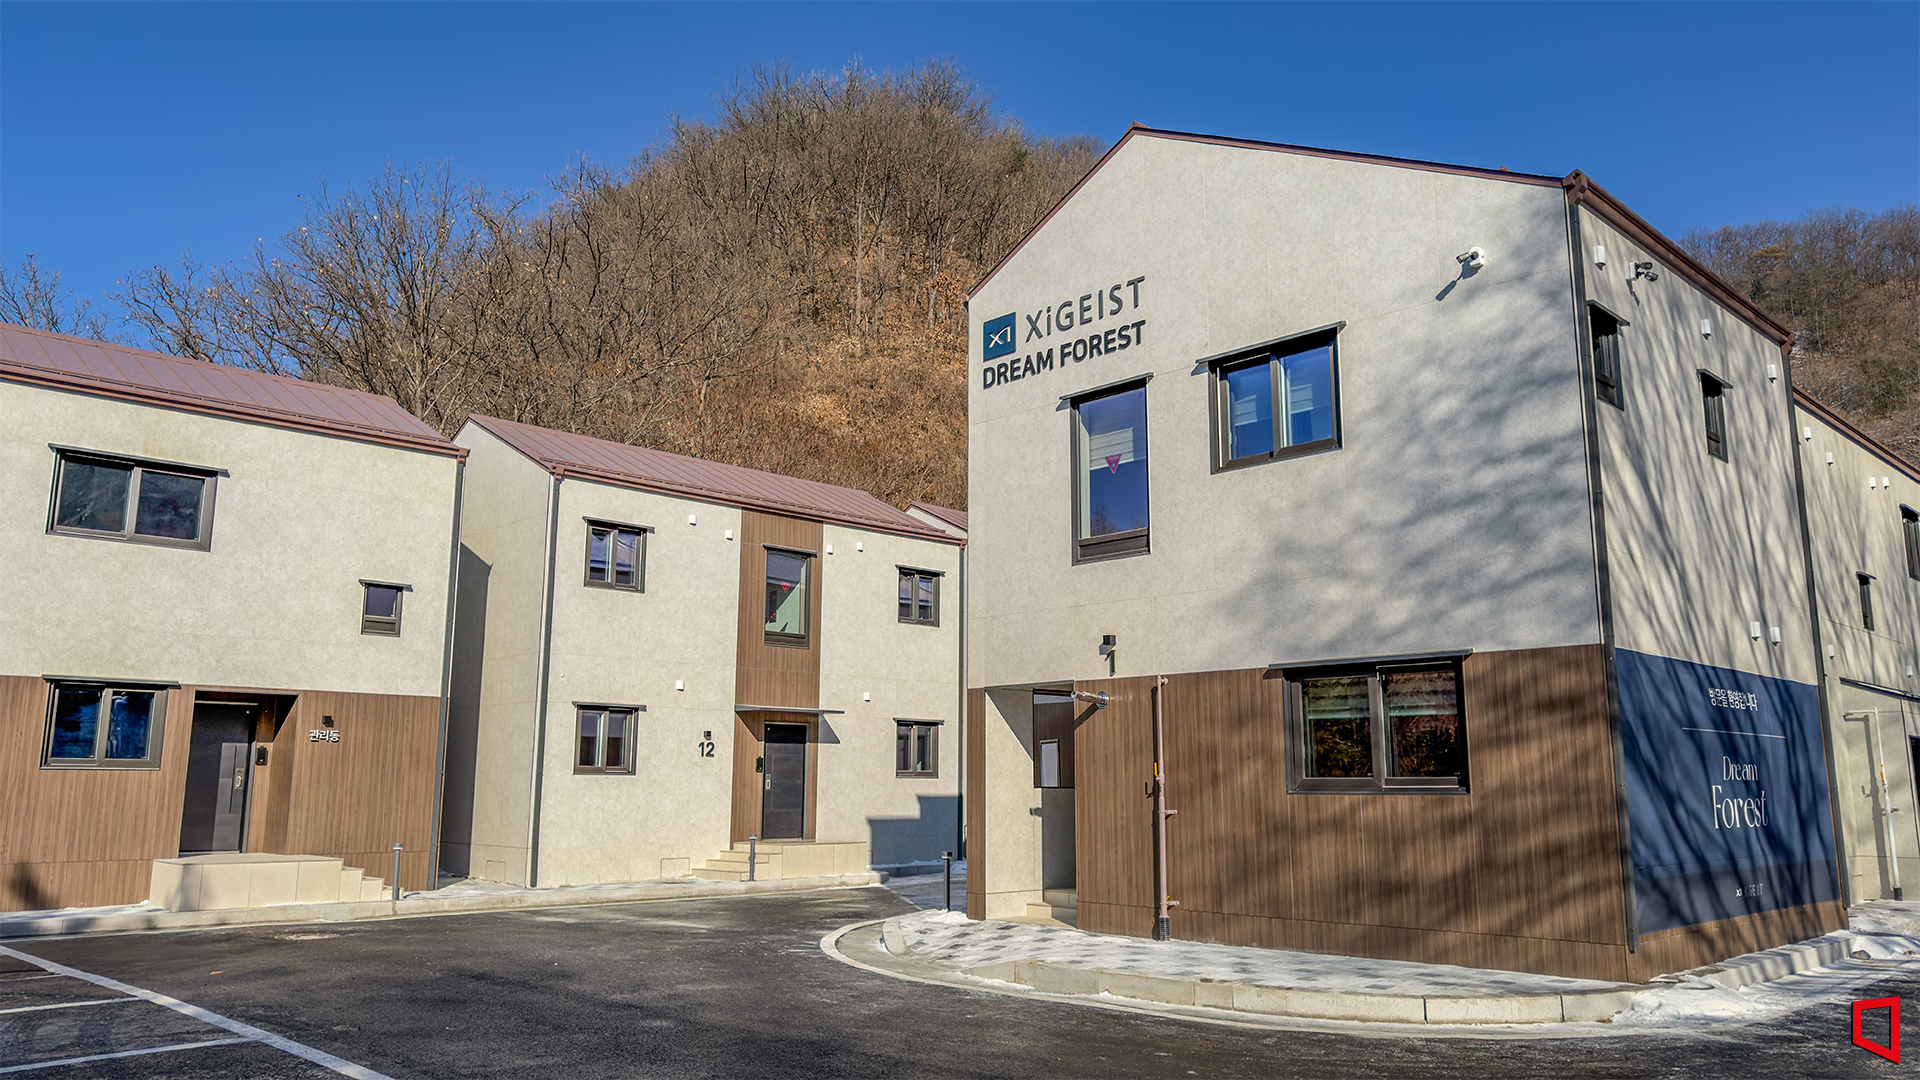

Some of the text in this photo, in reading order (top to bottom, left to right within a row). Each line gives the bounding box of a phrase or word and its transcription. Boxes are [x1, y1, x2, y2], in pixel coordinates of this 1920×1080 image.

[983, 319, 1146, 390] DREAM FOREST
[1708, 687, 1758, 711] 방문을 환영합니다
[309, 729, 340, 742] 관리동
[698, 741, 715, 757] 12
[1723, 755, 1759, 781] Dream
[1712, 784, 1769, 829] Forest
